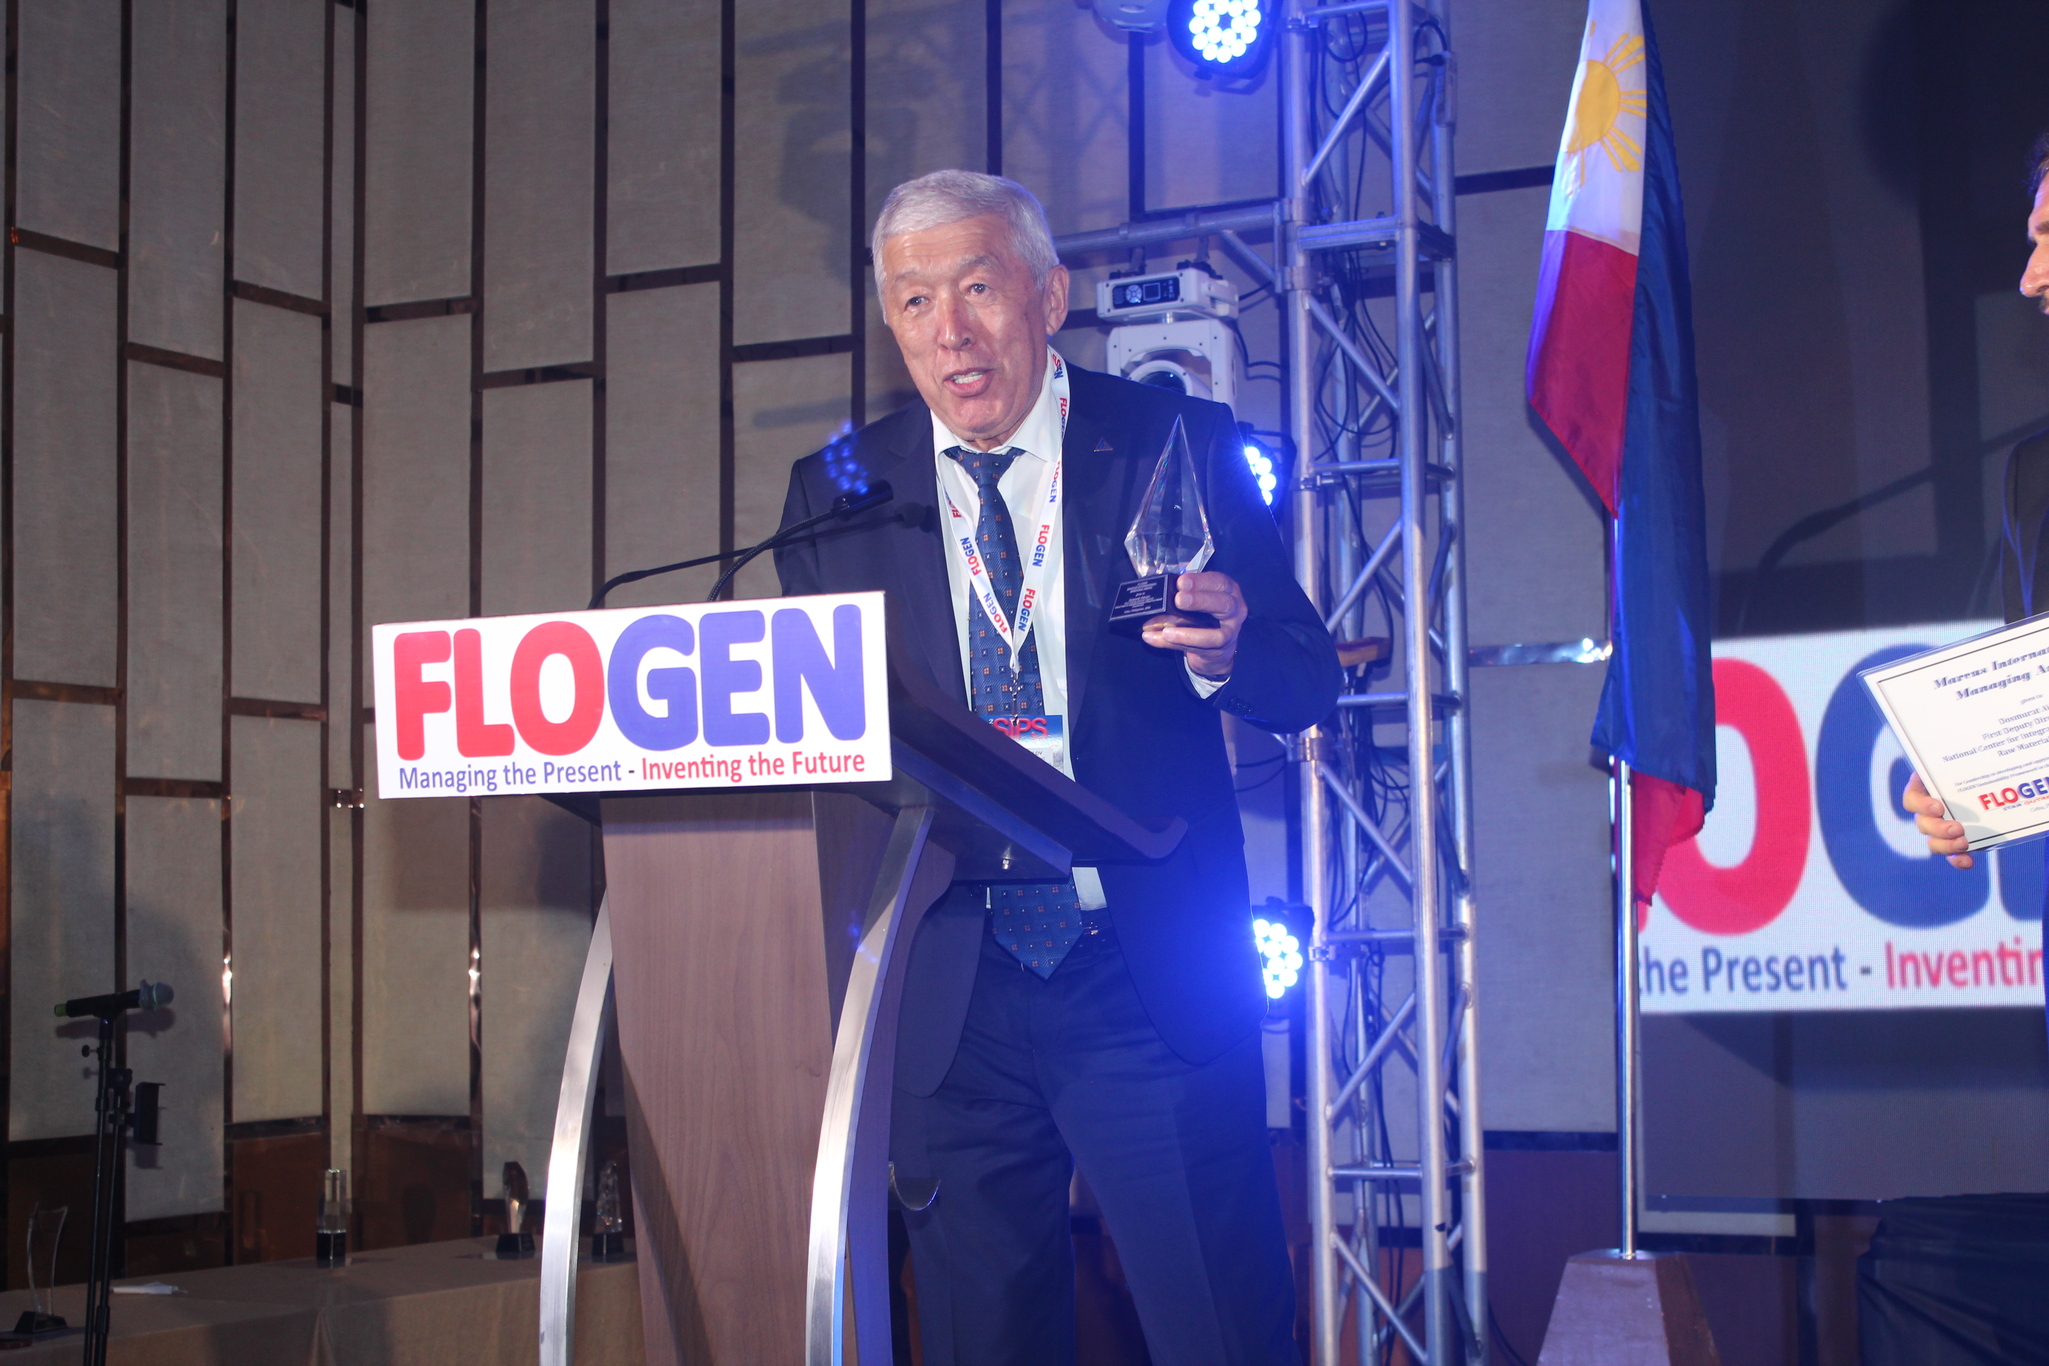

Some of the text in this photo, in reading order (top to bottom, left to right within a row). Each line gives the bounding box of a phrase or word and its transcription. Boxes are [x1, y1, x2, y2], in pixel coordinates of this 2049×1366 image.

[960, 537, 982, 576] FLOGEN
[1032, 524, 1050, 567] FLOGEN
[983, 592, 1008, 634] FLOGEN
[1018, 588, 1036, 632] FLOGEN
[393, 604, 866, 761] FLOGEN
[1933, 667, 1988, 690] Marcus
[1956, 671, 2032, 701] Managing
[1981, 730, 2002, 741] First
[2002, 720, 2033, 736] Deputy
[1998, 707, 2041, 725] Dosmurat
[1942, 748, 1977, 762] National
[1978, 738, 2006, 752] Center
[2006, 735, 2019, 744] for
[1997, 747, 2015, 758] Raw
[399, 764, 498, 793] Managing
[503, 762, 537, 786] the
[544, 760, 622, 784] Present
[642, 754, 743, 783] Inventing
[748, 751, 785, 776] the
[792, 751, 866, 775] Future
[1638, 945, 1689, 996] he
[1702, 944, 1848, 994] Present
